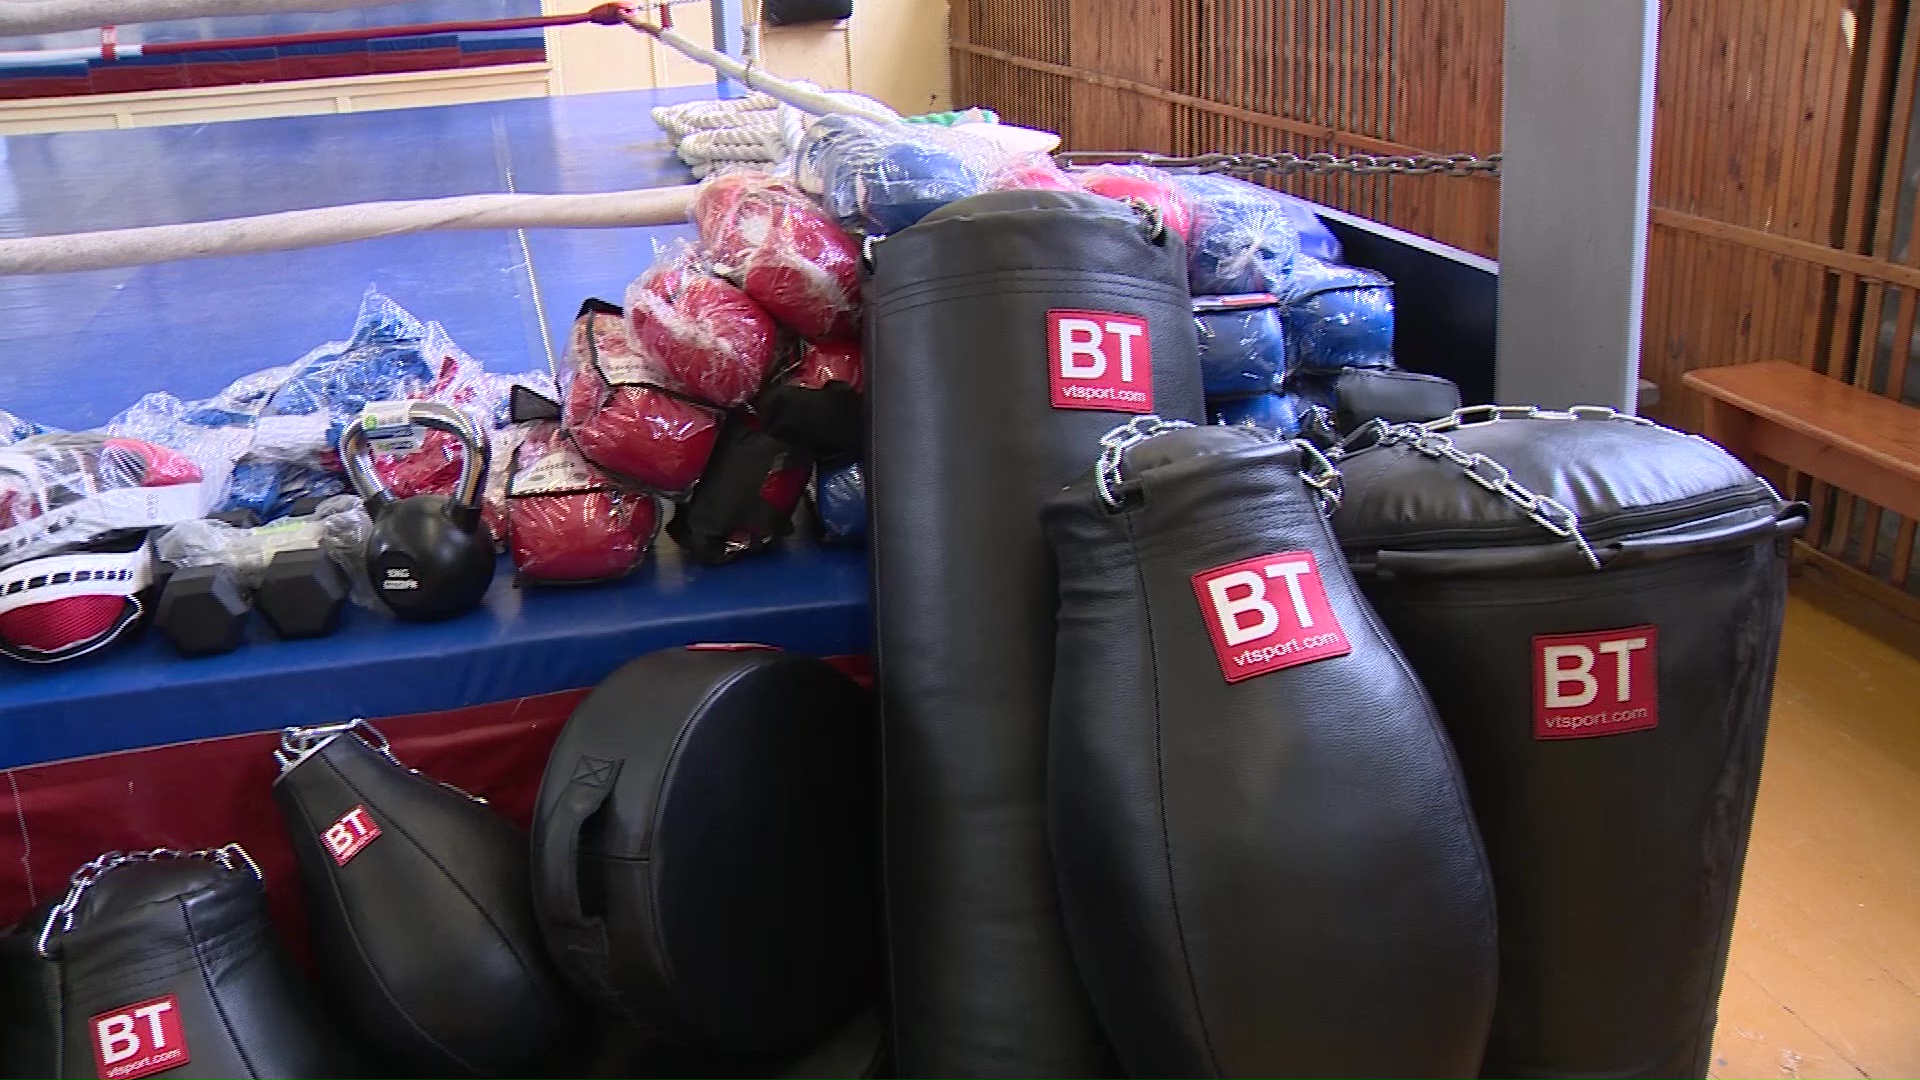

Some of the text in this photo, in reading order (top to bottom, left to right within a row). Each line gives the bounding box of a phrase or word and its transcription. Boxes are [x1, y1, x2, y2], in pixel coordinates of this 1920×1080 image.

[1059, 318, 1143, 382] BT
[1062, 385, 1146, 402] vtsport.com
[1207, 560, 1312, 647] BT
[1233, 632, 1340, 666] vtsport.com
[1544, 637, 1647, 709] BT
[1545, 707, 1648, 730] vtsport.com
[325, 808, 367, 855] BT
[97, 1001, 172, 1065] BT
[106, 1049, 182, 1077] vtsport.com
